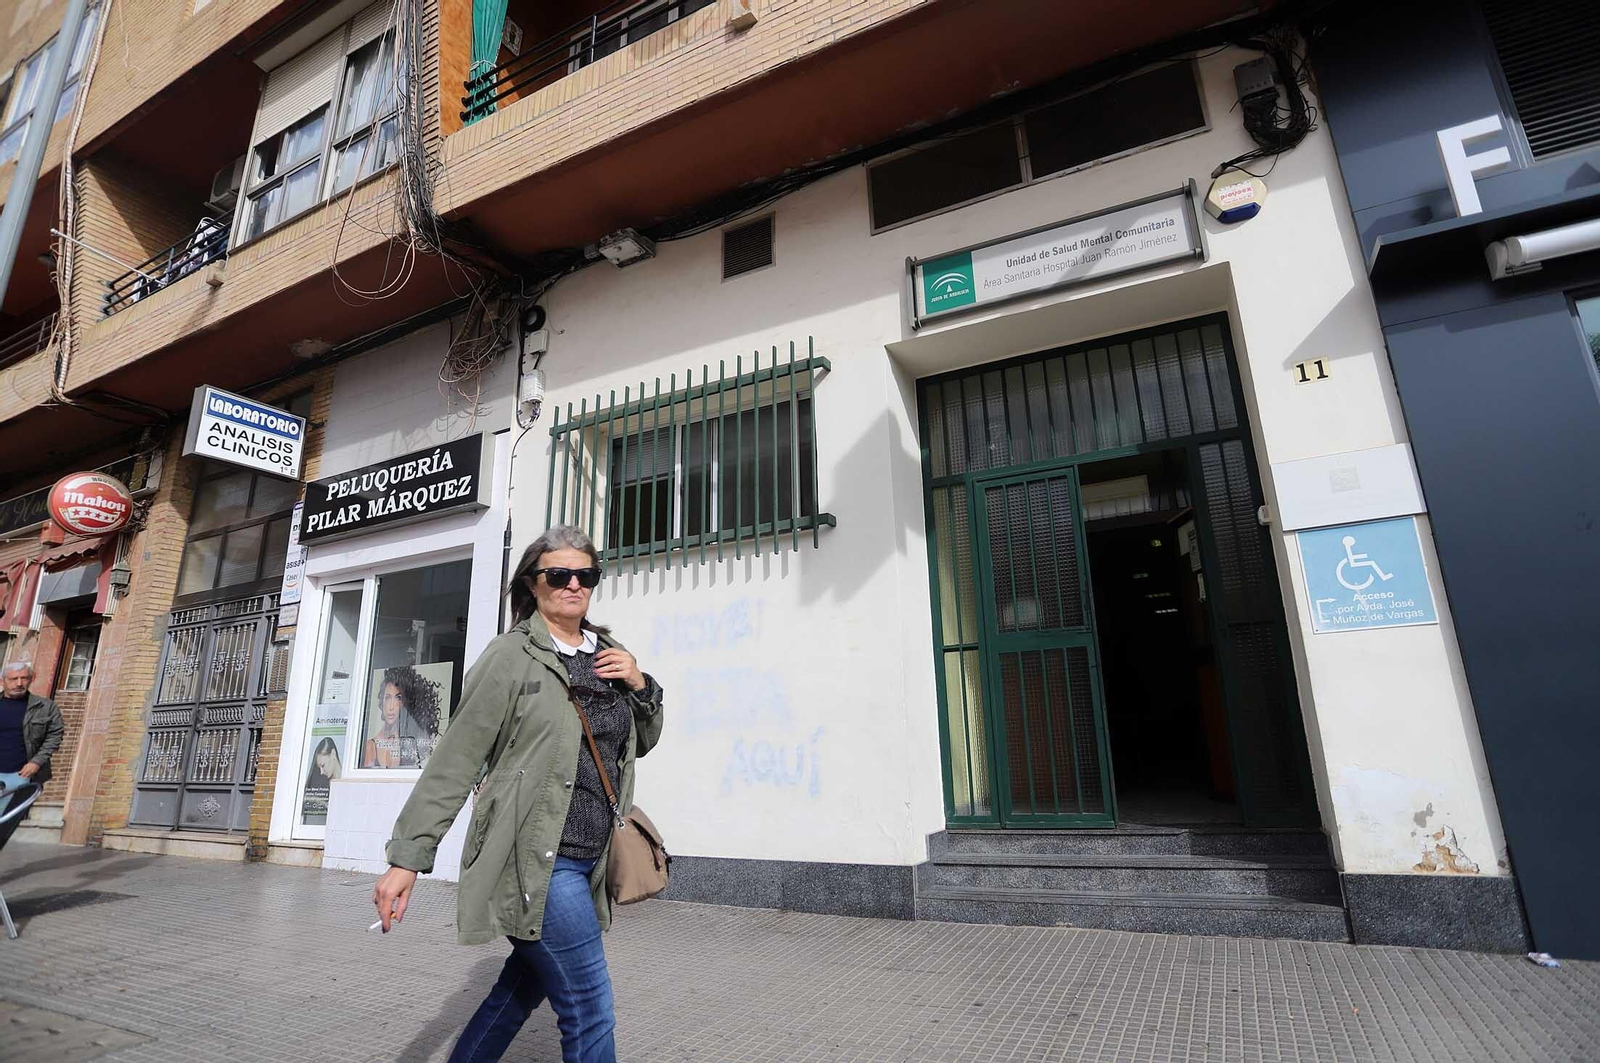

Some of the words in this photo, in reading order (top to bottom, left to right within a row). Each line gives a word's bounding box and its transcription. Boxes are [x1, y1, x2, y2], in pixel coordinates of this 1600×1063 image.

[1436, 114, 1511, 217] F
[1004, 268, 1041, 285] Sanitaria
[1043, 259, 1078, 276] Hospital
[1080, 251, 1102, 266] Juan
[1104, 242, 1137, 259] Ramón
[1139, 232, 1178, 251] Jiménez
[1006, 255, 1038, 269] Unidad
[1039, 250, 1050, 261] de
[1052, 242, 1078, 257] Salud
[1080, 232, 1113, 249] Mental
[1115, 217, 1175, 240] Comunitaria
[1296, 359, 1329, 383] 11
[209, 397, 299, 435] LABORATORIO
[207, 435, 293, 467] CLINICOS
[209, 422, 293, 454] ANALISIS
[326, 448, 454, 502] PELUQUERÍA
[306, 503, 361, 533] PILAR
[366, 475, 472, 519] MÁRQUEZ
[1337, 604, 1354, 616] por
[1389, 598, 1415, 609] José
[1353, 591, 1394, 602] Acceso
[1333, 613, 1367, 625] Muñoz
[1370, 613, 1384, 621] de
[1386, 609, 1424, 621] Vargas
